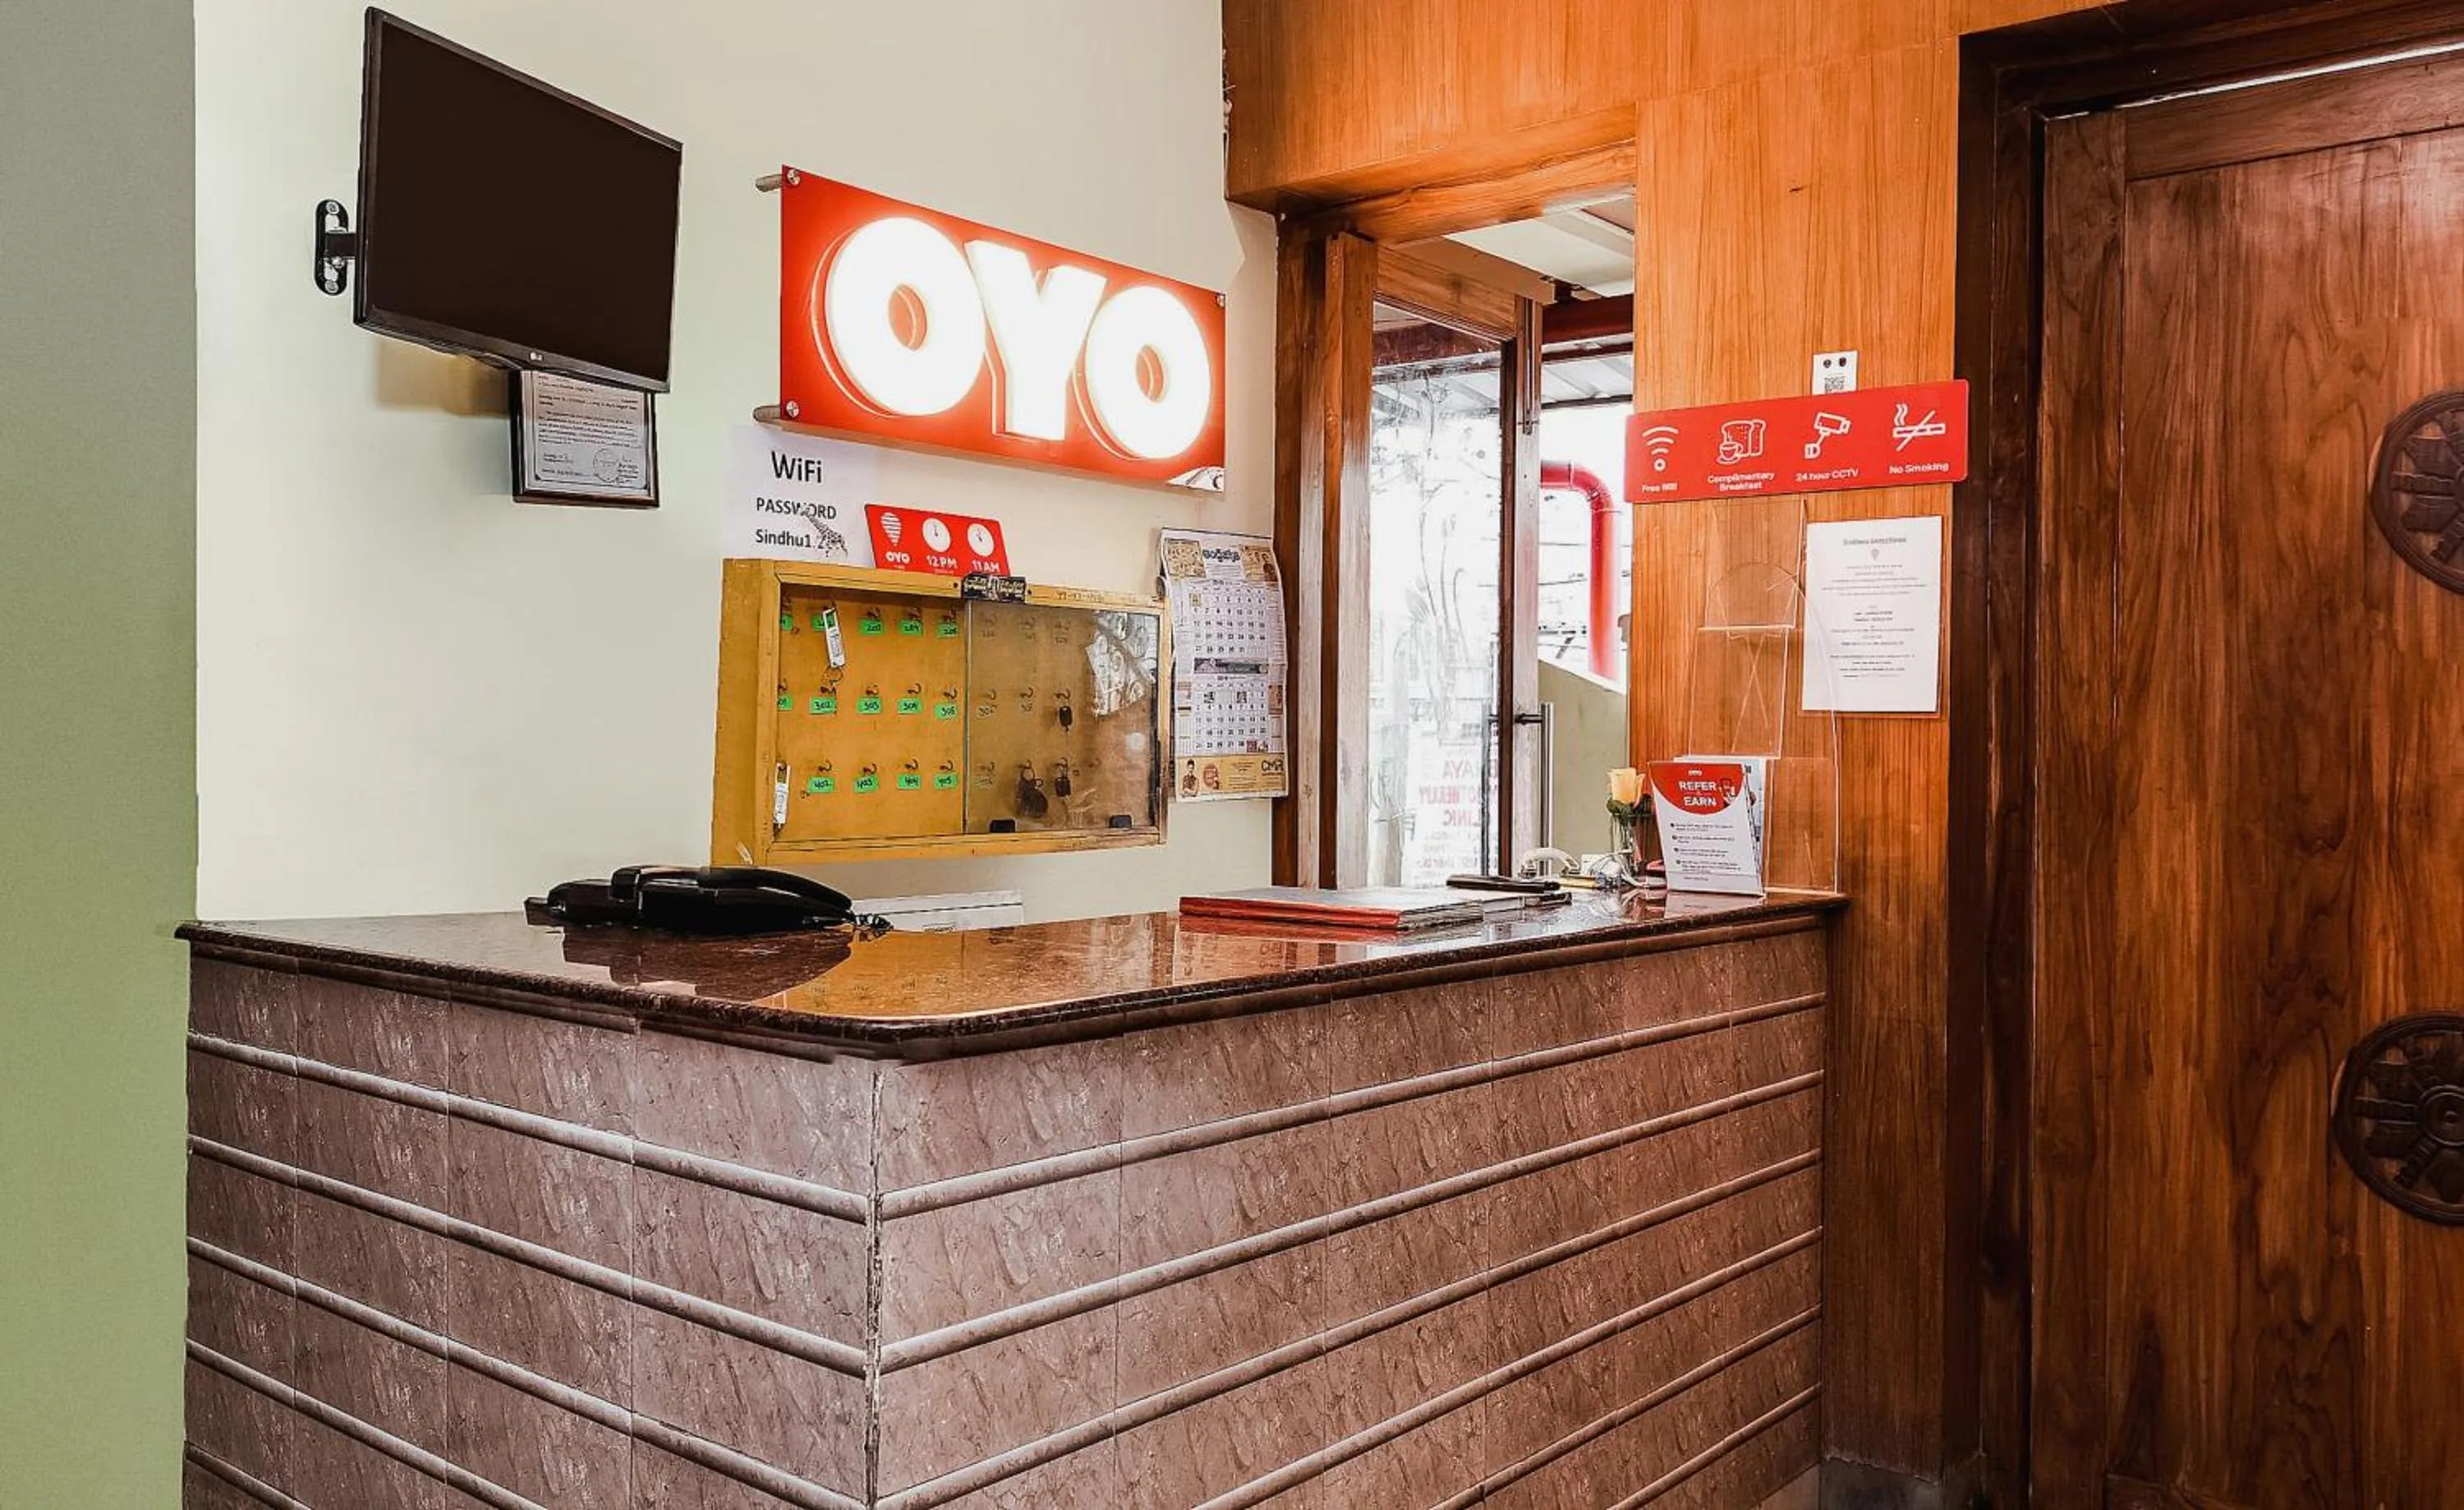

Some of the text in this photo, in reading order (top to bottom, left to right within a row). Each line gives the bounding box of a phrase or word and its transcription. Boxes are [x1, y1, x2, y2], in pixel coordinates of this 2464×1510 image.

[812, 217, 1211, 460] OYO
[771, 450, 822, 484] WiFi
[1832, 467, 1859, 479] CCTV
[1889, 463, 1949, 474] No Smoking
[885, 551, 910, 564] OYO
[926, 555, 958, 569] 12 PM
[983, 561, 1000, 573] AM
[1678, 781, 1717, 791] REFER
[1684, 796, 1717, 806] EARN
